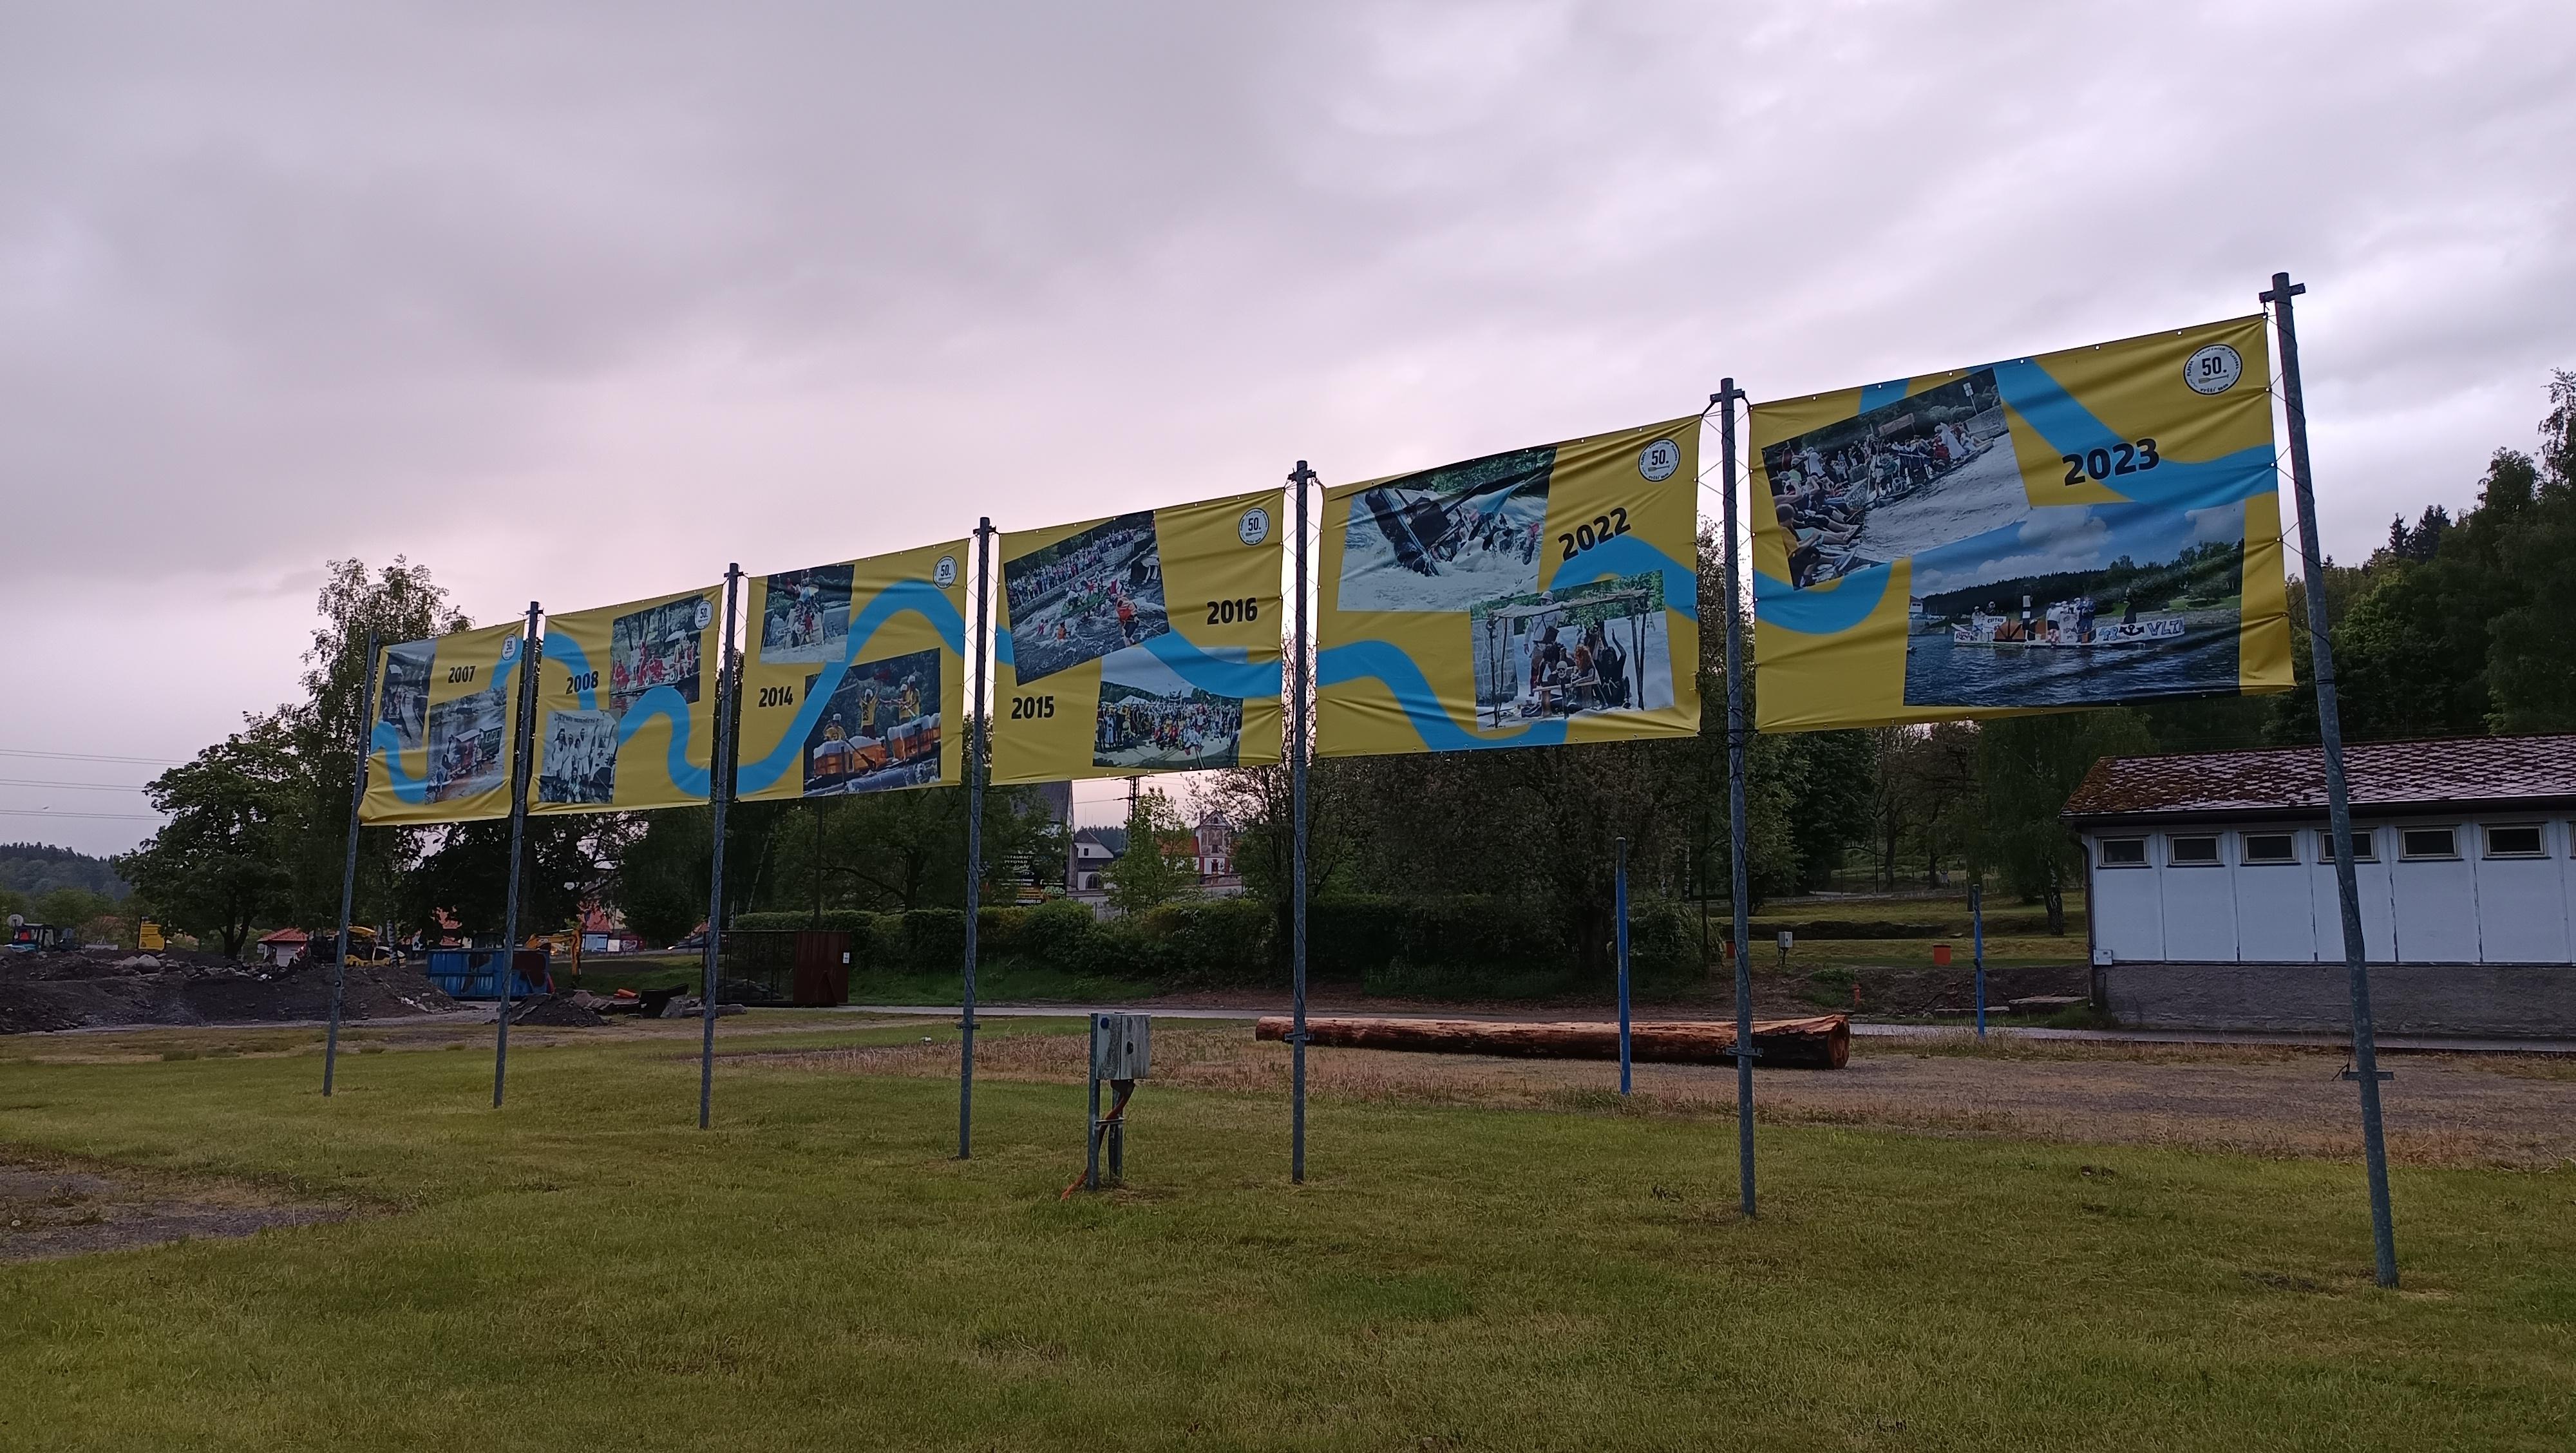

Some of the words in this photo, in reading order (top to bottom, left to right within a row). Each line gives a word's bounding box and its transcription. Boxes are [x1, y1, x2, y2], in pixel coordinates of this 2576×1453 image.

[2201, 356, 2228, 376] 50.
[1651, 449, 1669, 466] 50.
[2062, 438, 2160, 486] 2023
[1248, 517, 1262, 531] 50.
[1558, 507, 1631, 562] 2022
[940, 564, 951, 577] 50.
[700, 607, 709, 619] 50.
[1207, 597, 1258, 625] 2016
[448, 665, 477, 684] 2007
[565, 670, 599, 695] 2008
[758, 685, 793, 708] 2014
[1011, 696, 1055, 719] 2015
